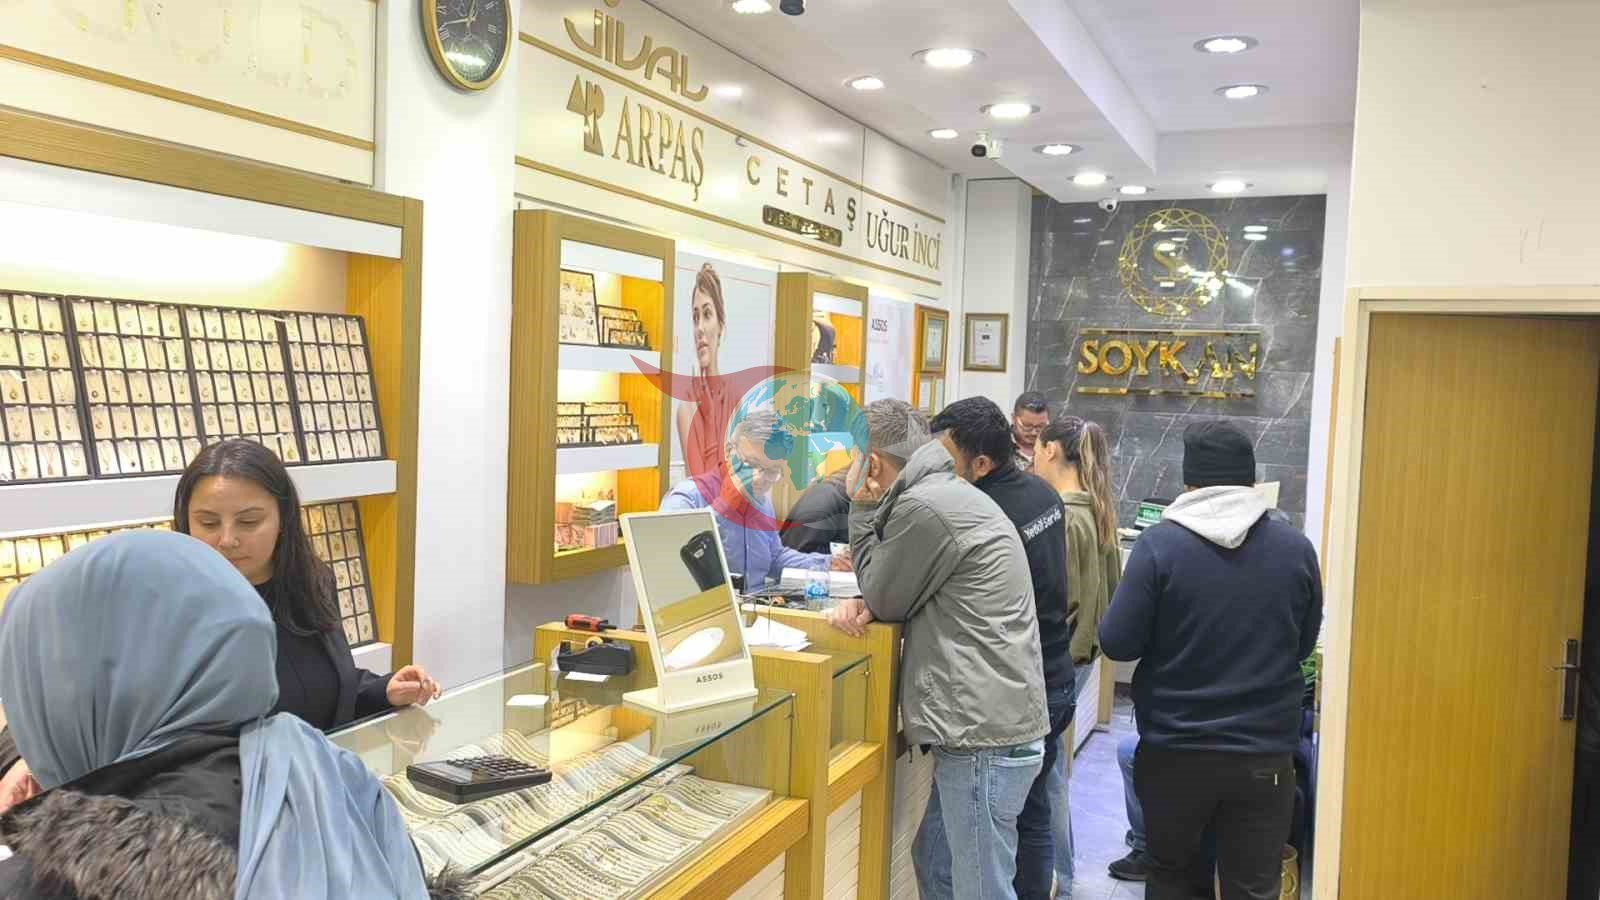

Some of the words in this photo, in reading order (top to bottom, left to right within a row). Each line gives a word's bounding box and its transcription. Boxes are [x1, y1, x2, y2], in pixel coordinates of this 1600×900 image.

[611, 95, 704, 202] ARPAŞ
[746, 155, 857, 232] CETAŞ
[866, 209, 909, 260] UĞUR
[912, 223, 942, 270] İNCİ
[1078, 339, 1257, 385] SOYKAN
[696, 672, 724, 684] ASSOS
